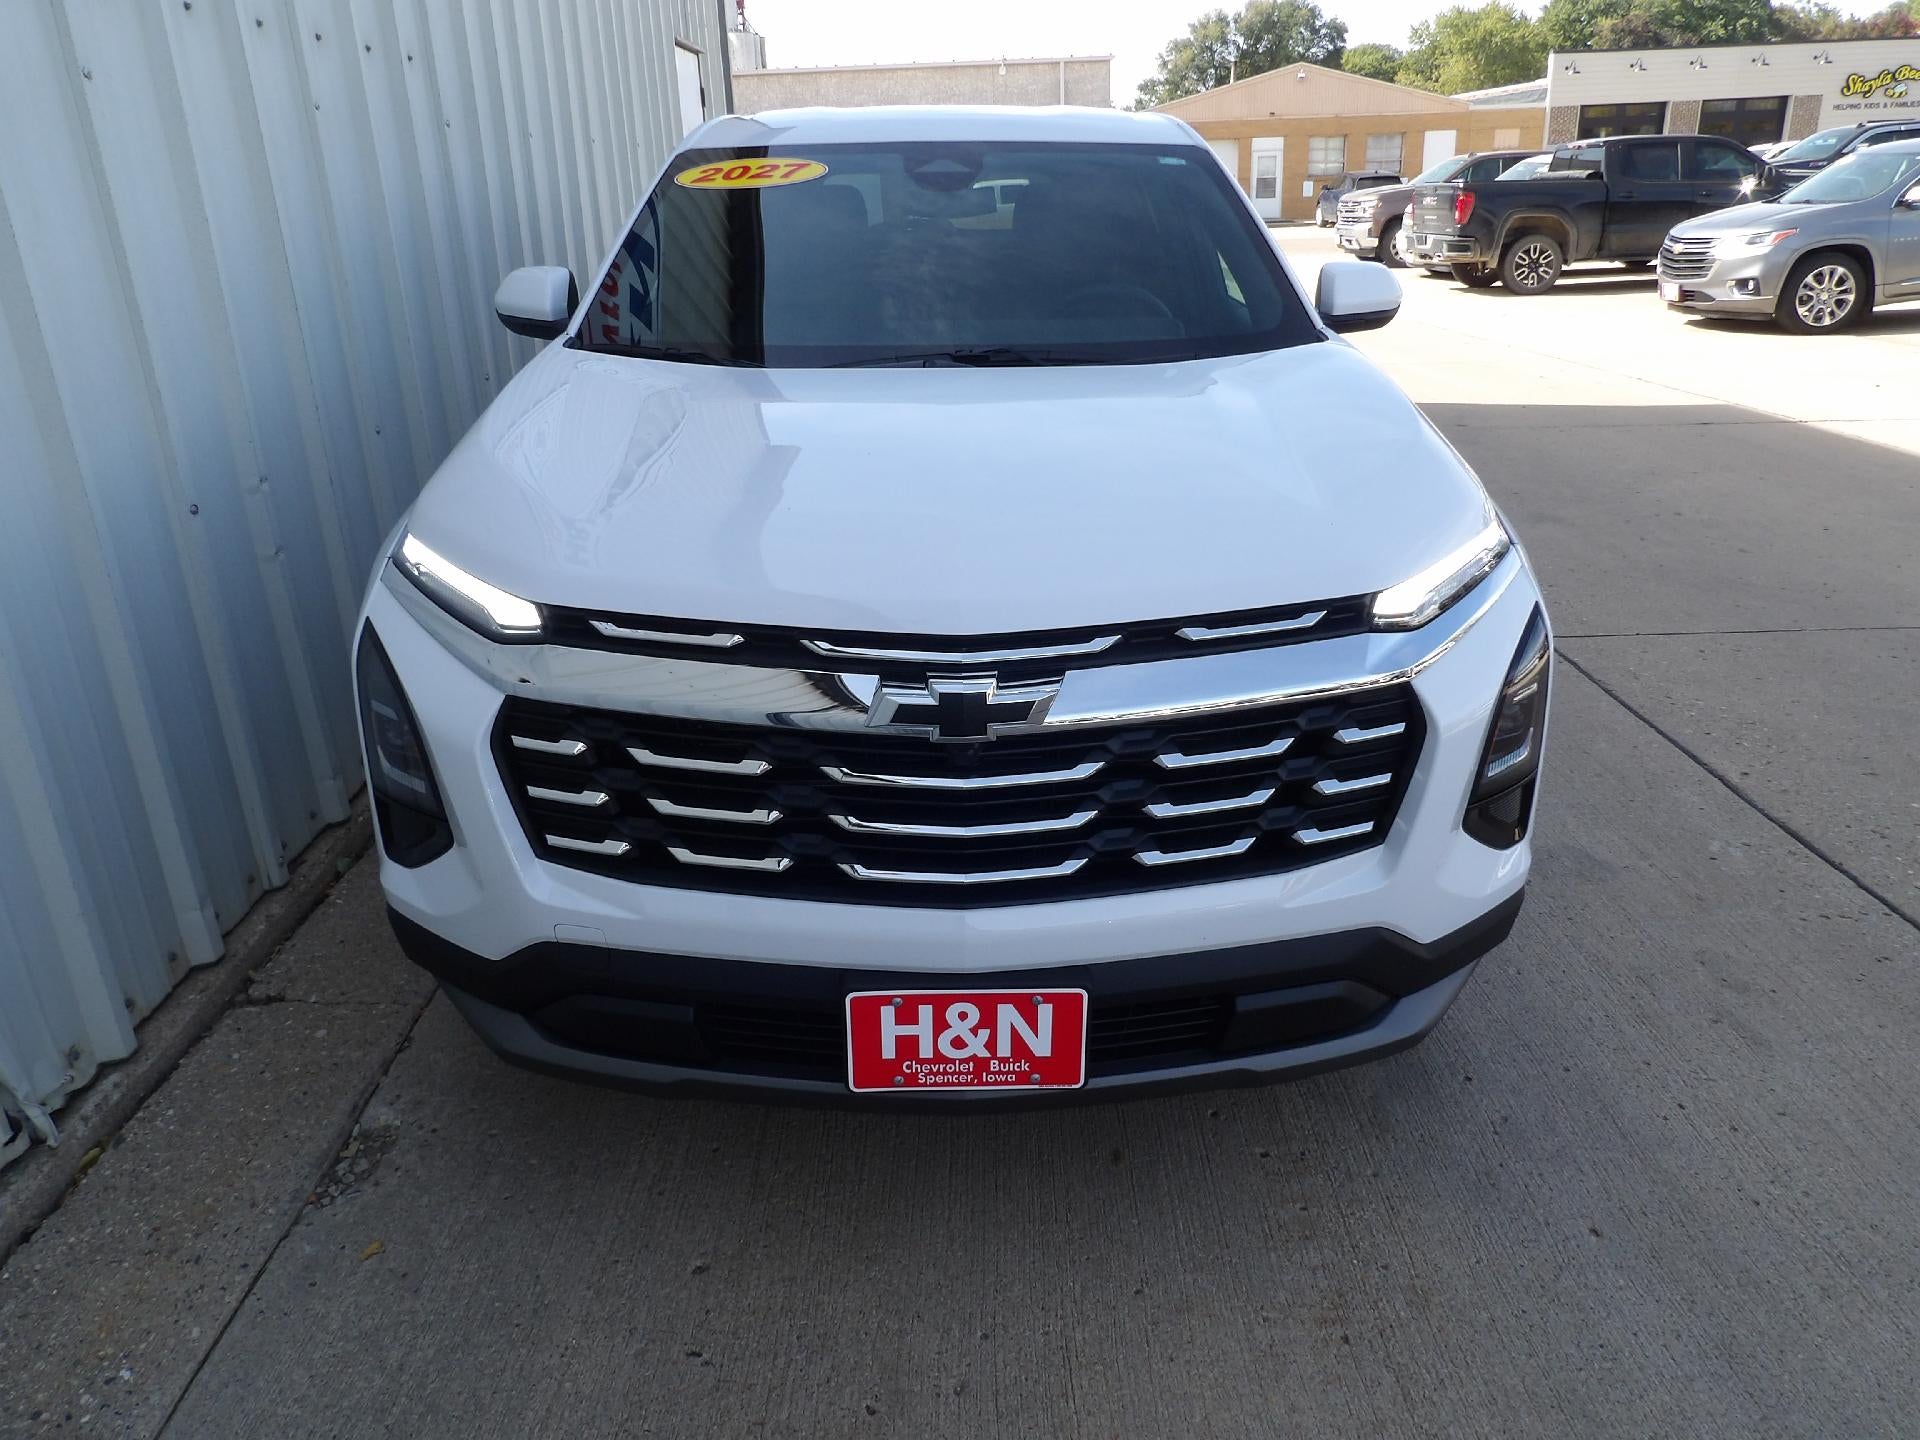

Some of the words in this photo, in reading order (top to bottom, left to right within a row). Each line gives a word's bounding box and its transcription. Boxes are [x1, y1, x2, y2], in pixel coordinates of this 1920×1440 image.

[1842, 69, 1893, 98] Shayla
[1832, 103, 1861, 111] HELPING
[689, 163, 811, 184] 2027
[880, 1002, 1053, 1060] H&N
[903, 1060, 975, 1073] Chevrolet
[990, 1059, 1030, 1072] Buick
[918, 1072, 978, 1085] Spencer,
[982, 1072, 1016, 1083] Iowa
